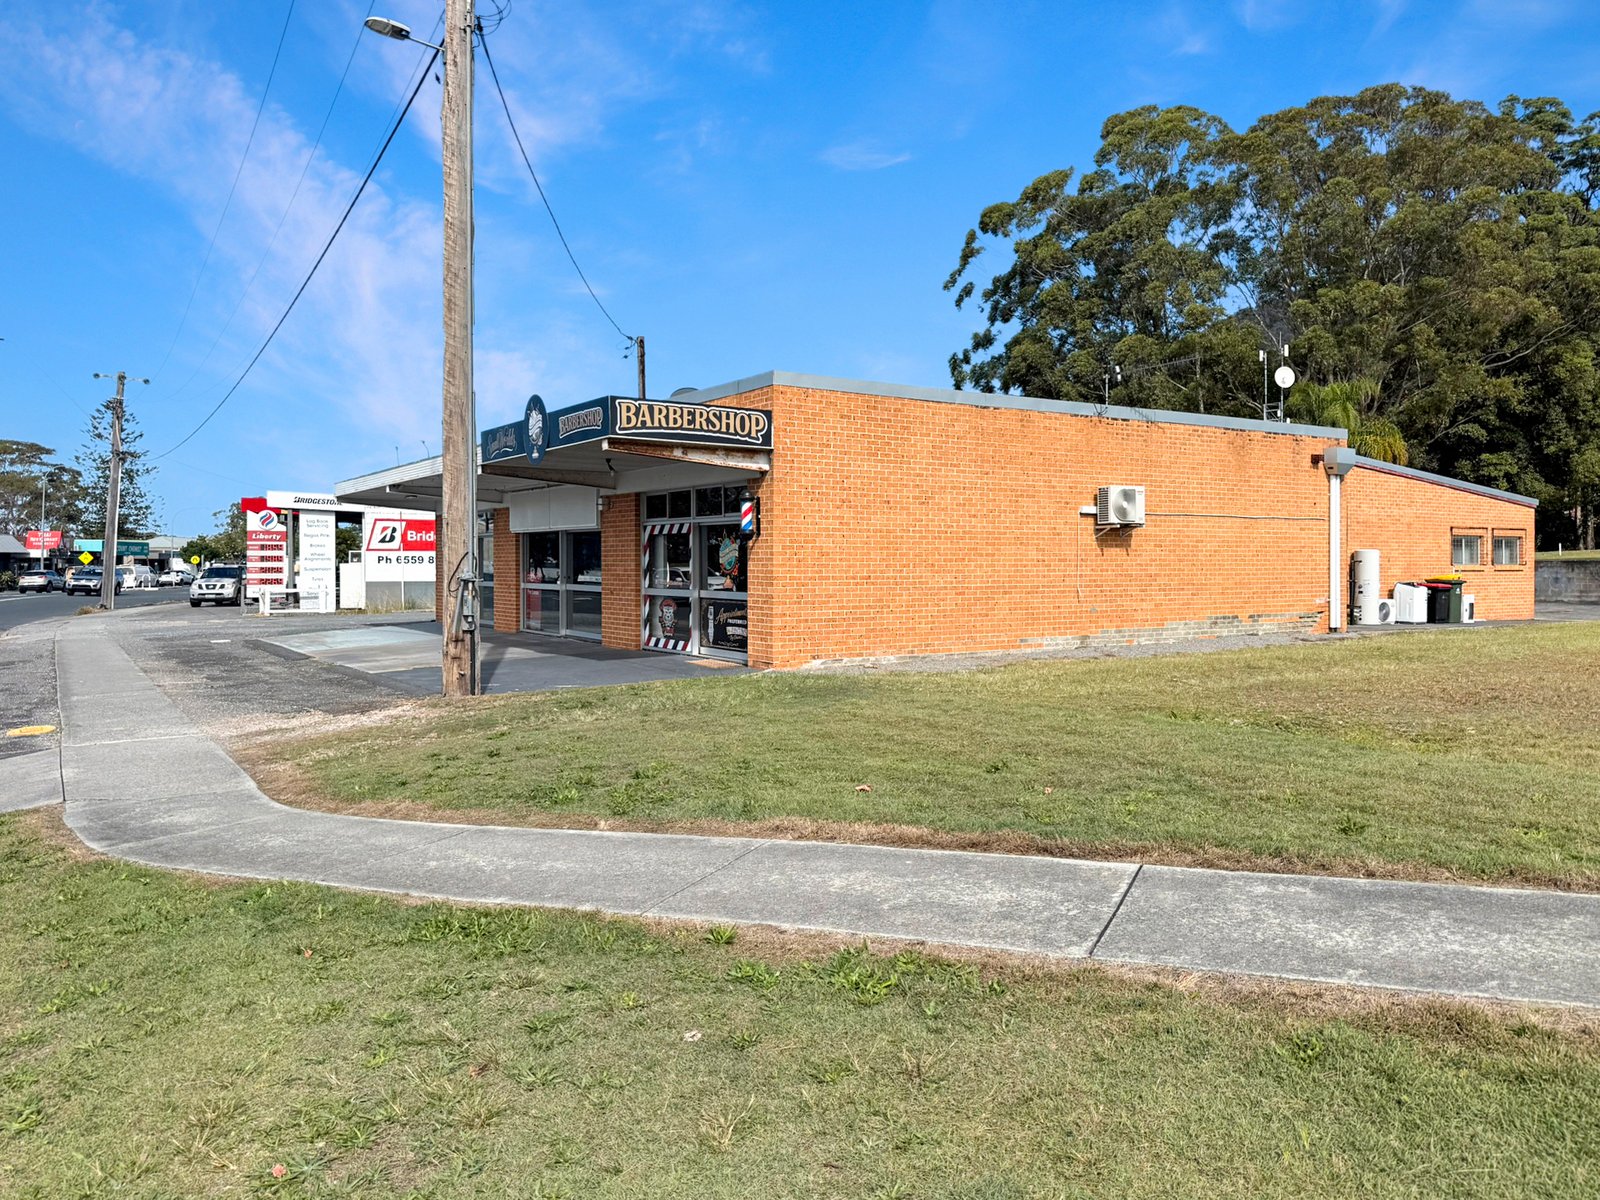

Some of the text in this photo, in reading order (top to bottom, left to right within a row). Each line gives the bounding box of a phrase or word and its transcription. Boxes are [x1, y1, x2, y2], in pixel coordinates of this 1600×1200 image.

[560, 408, 602, 432] BARBERSHOP
[620, 401, 766, 438] BARBERSHOP
[294, 496, 342, 506] BRIDGESTO
[252, 532, 282, 541] Liberty
[407, 530, 436, 542] Brid
[378, 556, 392, 564] Ph
[396, 556, 424, 564] 6559
